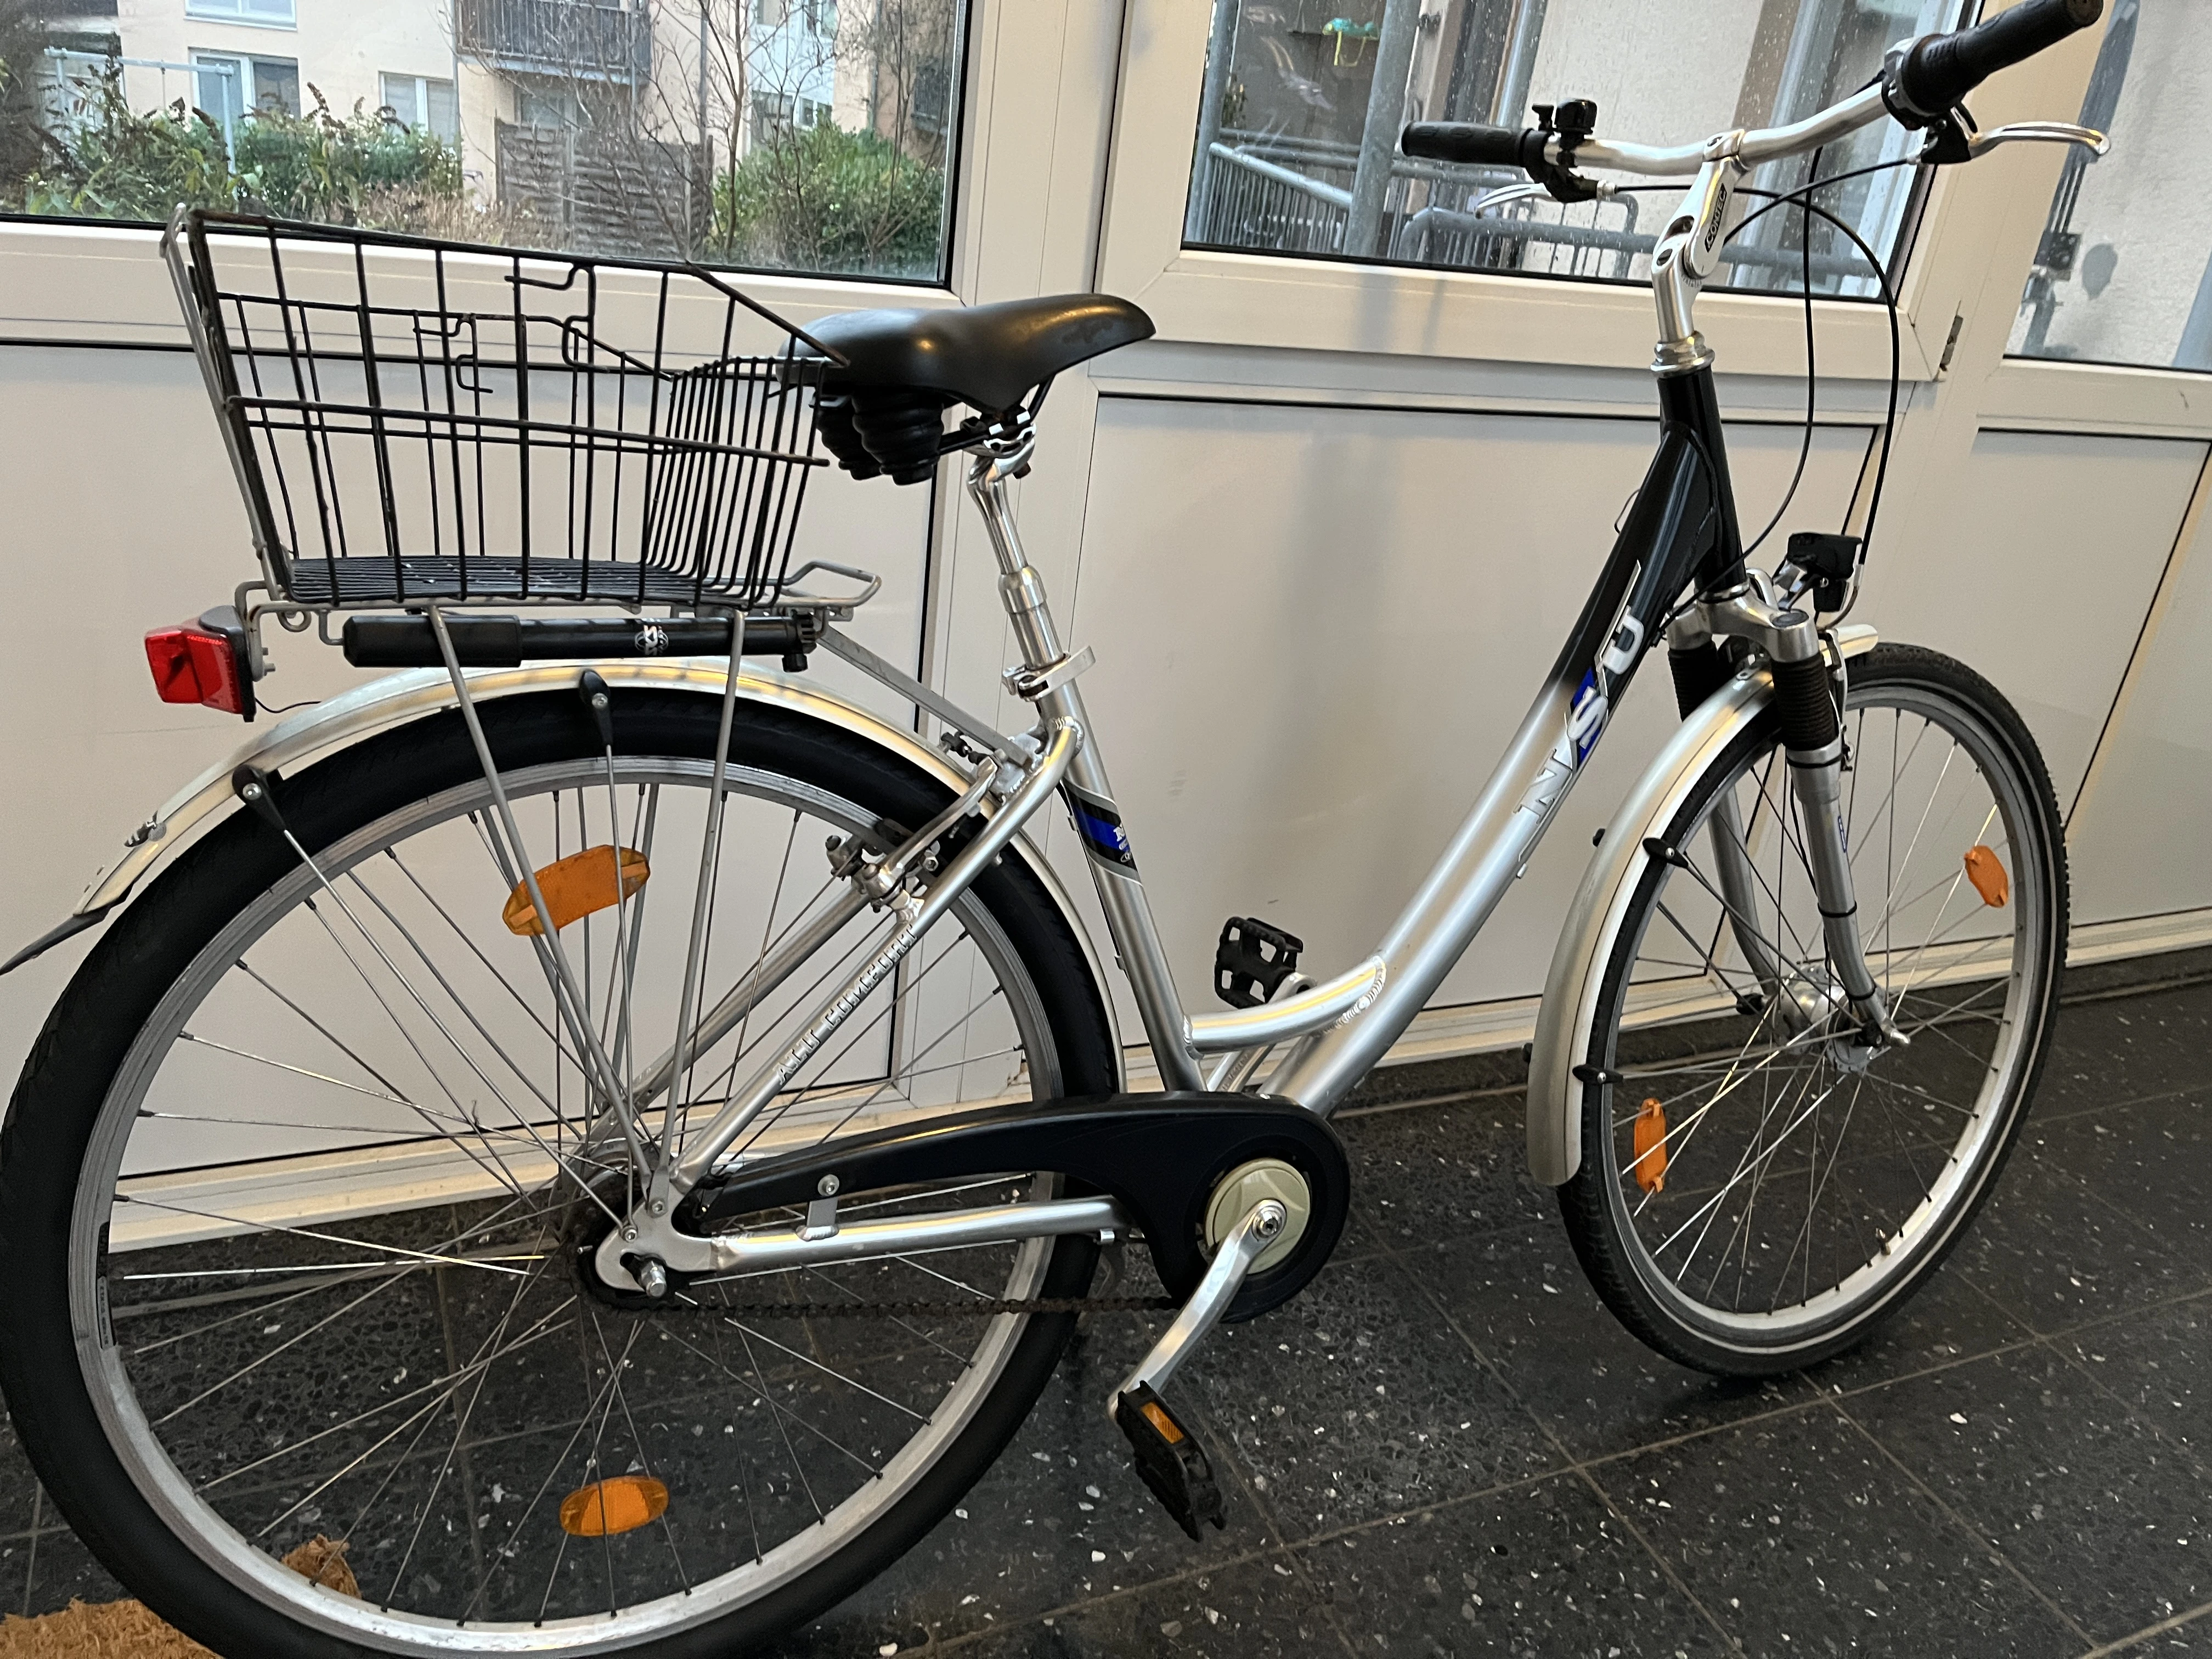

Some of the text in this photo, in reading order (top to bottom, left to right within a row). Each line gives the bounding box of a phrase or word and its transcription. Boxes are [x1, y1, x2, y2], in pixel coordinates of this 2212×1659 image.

[1706, 190, 1726, 249] CONTEC
[1513, 605, 1645, 825] NSU
[772, 924, 917, 1085] ALU COMFORT
